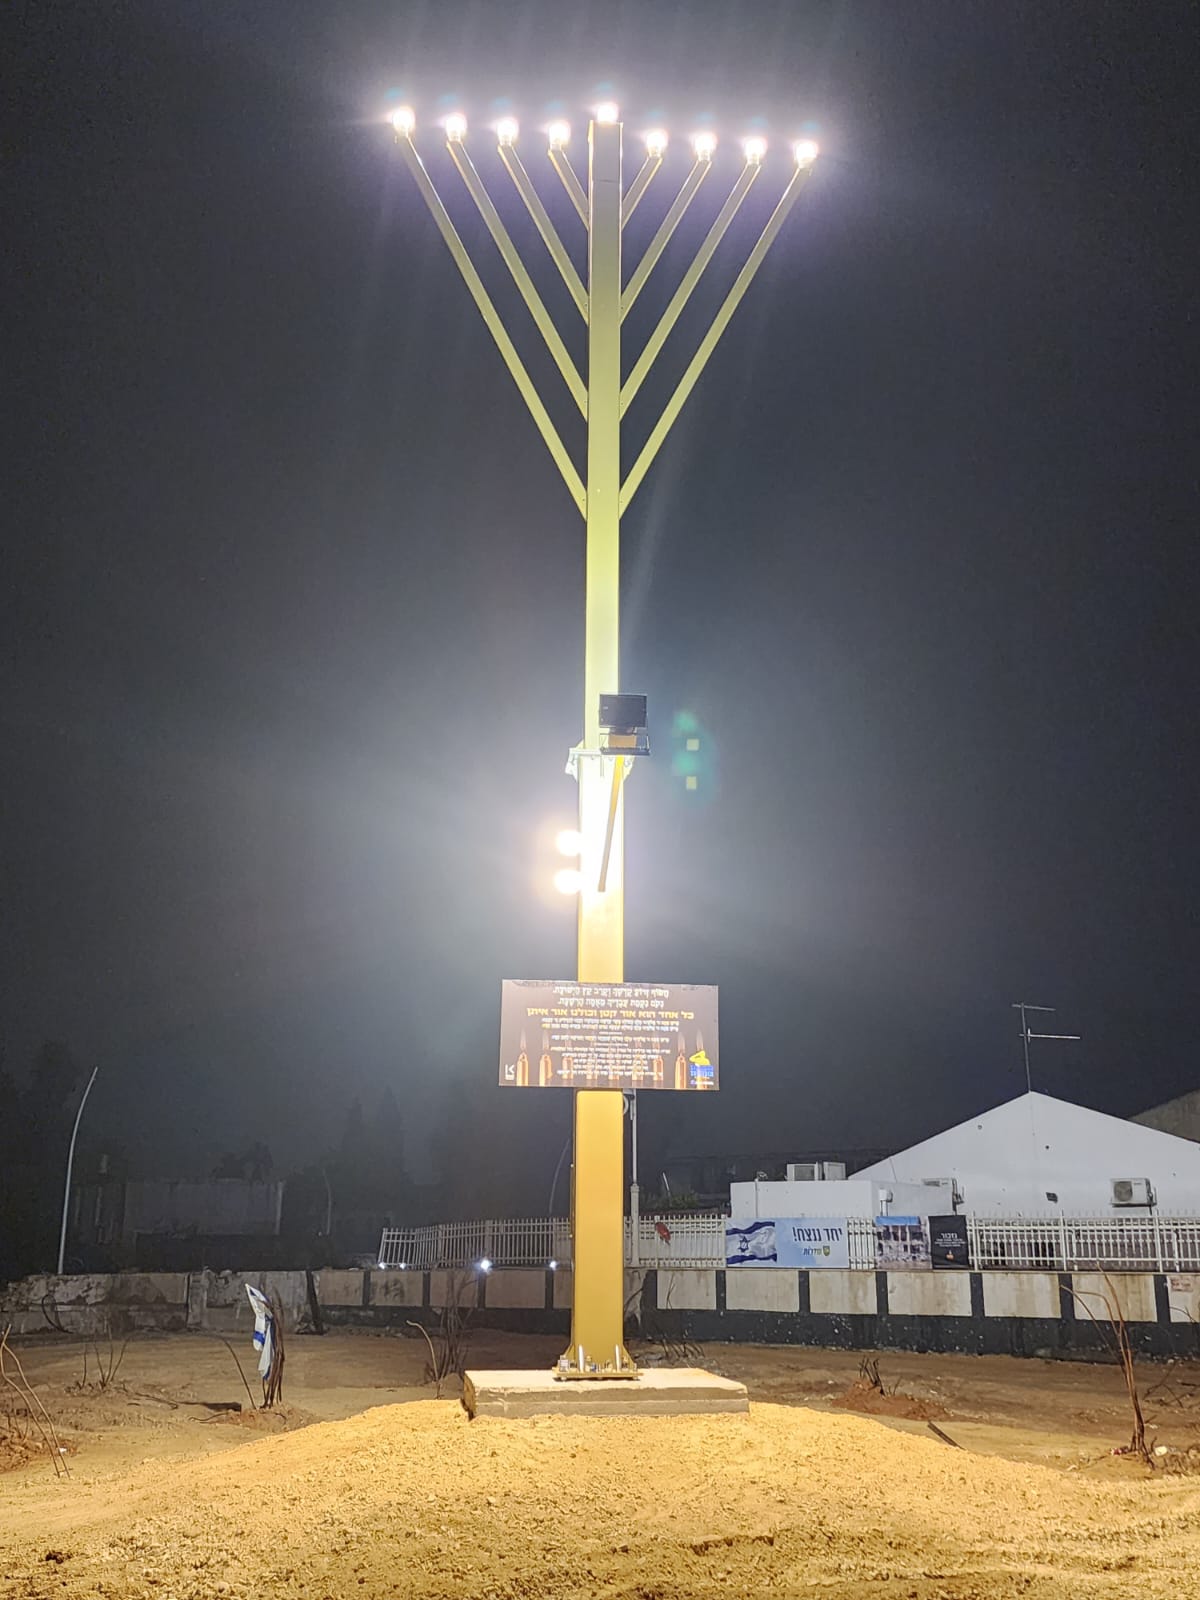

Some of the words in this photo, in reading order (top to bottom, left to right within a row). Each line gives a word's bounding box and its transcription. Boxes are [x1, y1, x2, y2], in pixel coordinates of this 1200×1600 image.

[527, 1007, 549, 1017] איתן
[551, 1008, 568, 1017] אור
[599, 1009, 617, 1019] קטן
[620, 1010, 636, 1019] אור
[639, 1010, 656, 1019] הוא
[658, 1011, 679, 1019] אחד
[681, 1010, 695, 1020] כל
[792, 1226, 822, 1242] ננצח!
[823, 1227, 843, 1241] יחד
